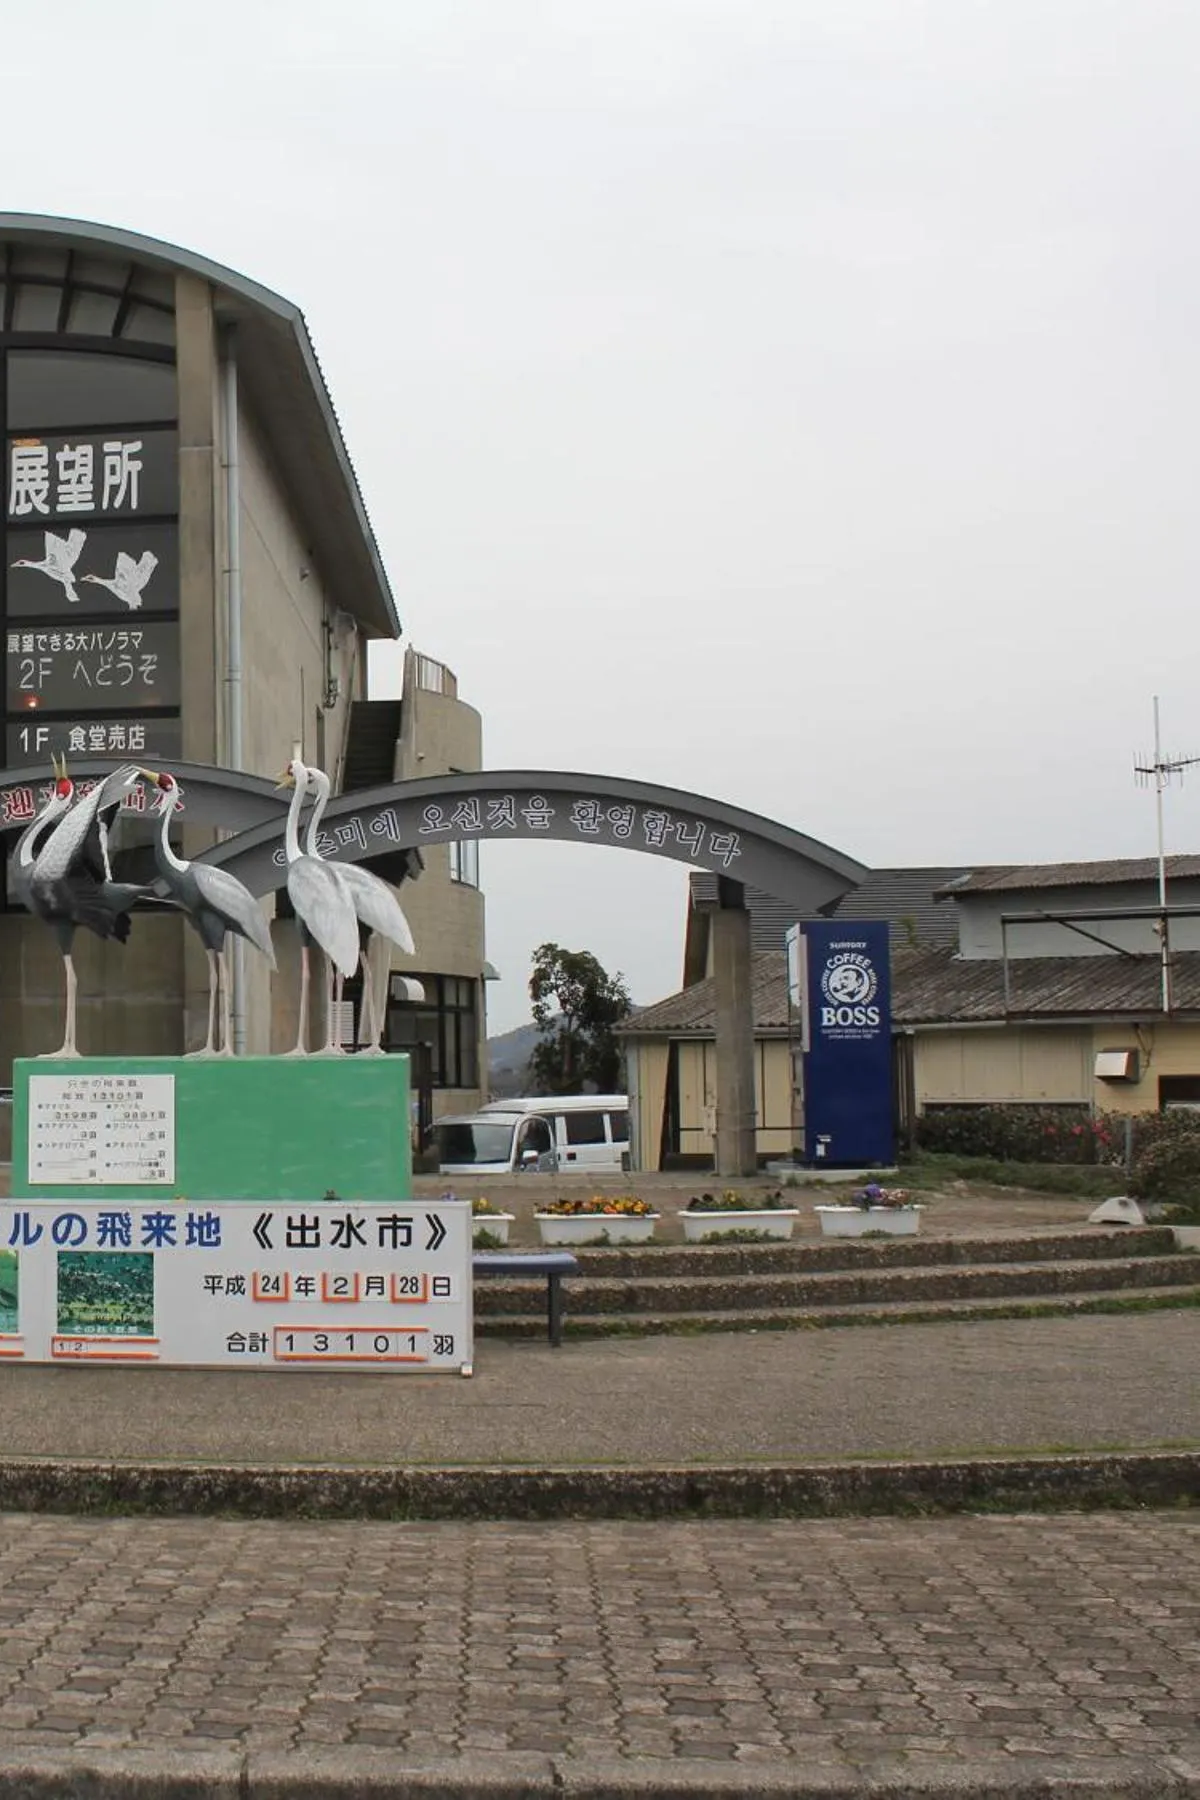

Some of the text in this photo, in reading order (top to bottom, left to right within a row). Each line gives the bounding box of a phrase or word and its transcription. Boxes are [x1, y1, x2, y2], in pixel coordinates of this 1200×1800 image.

[19, 658, 52, 688] 2F
[20, 724, 145, 753] 1F 食堂売店
[419, 795, 555, 834] 오신것을
[569, 800, 741, 867] 환영합니다
[826, 952, 872, 969] COFFEE
[821, 1005, 880, 1027] BOSS
